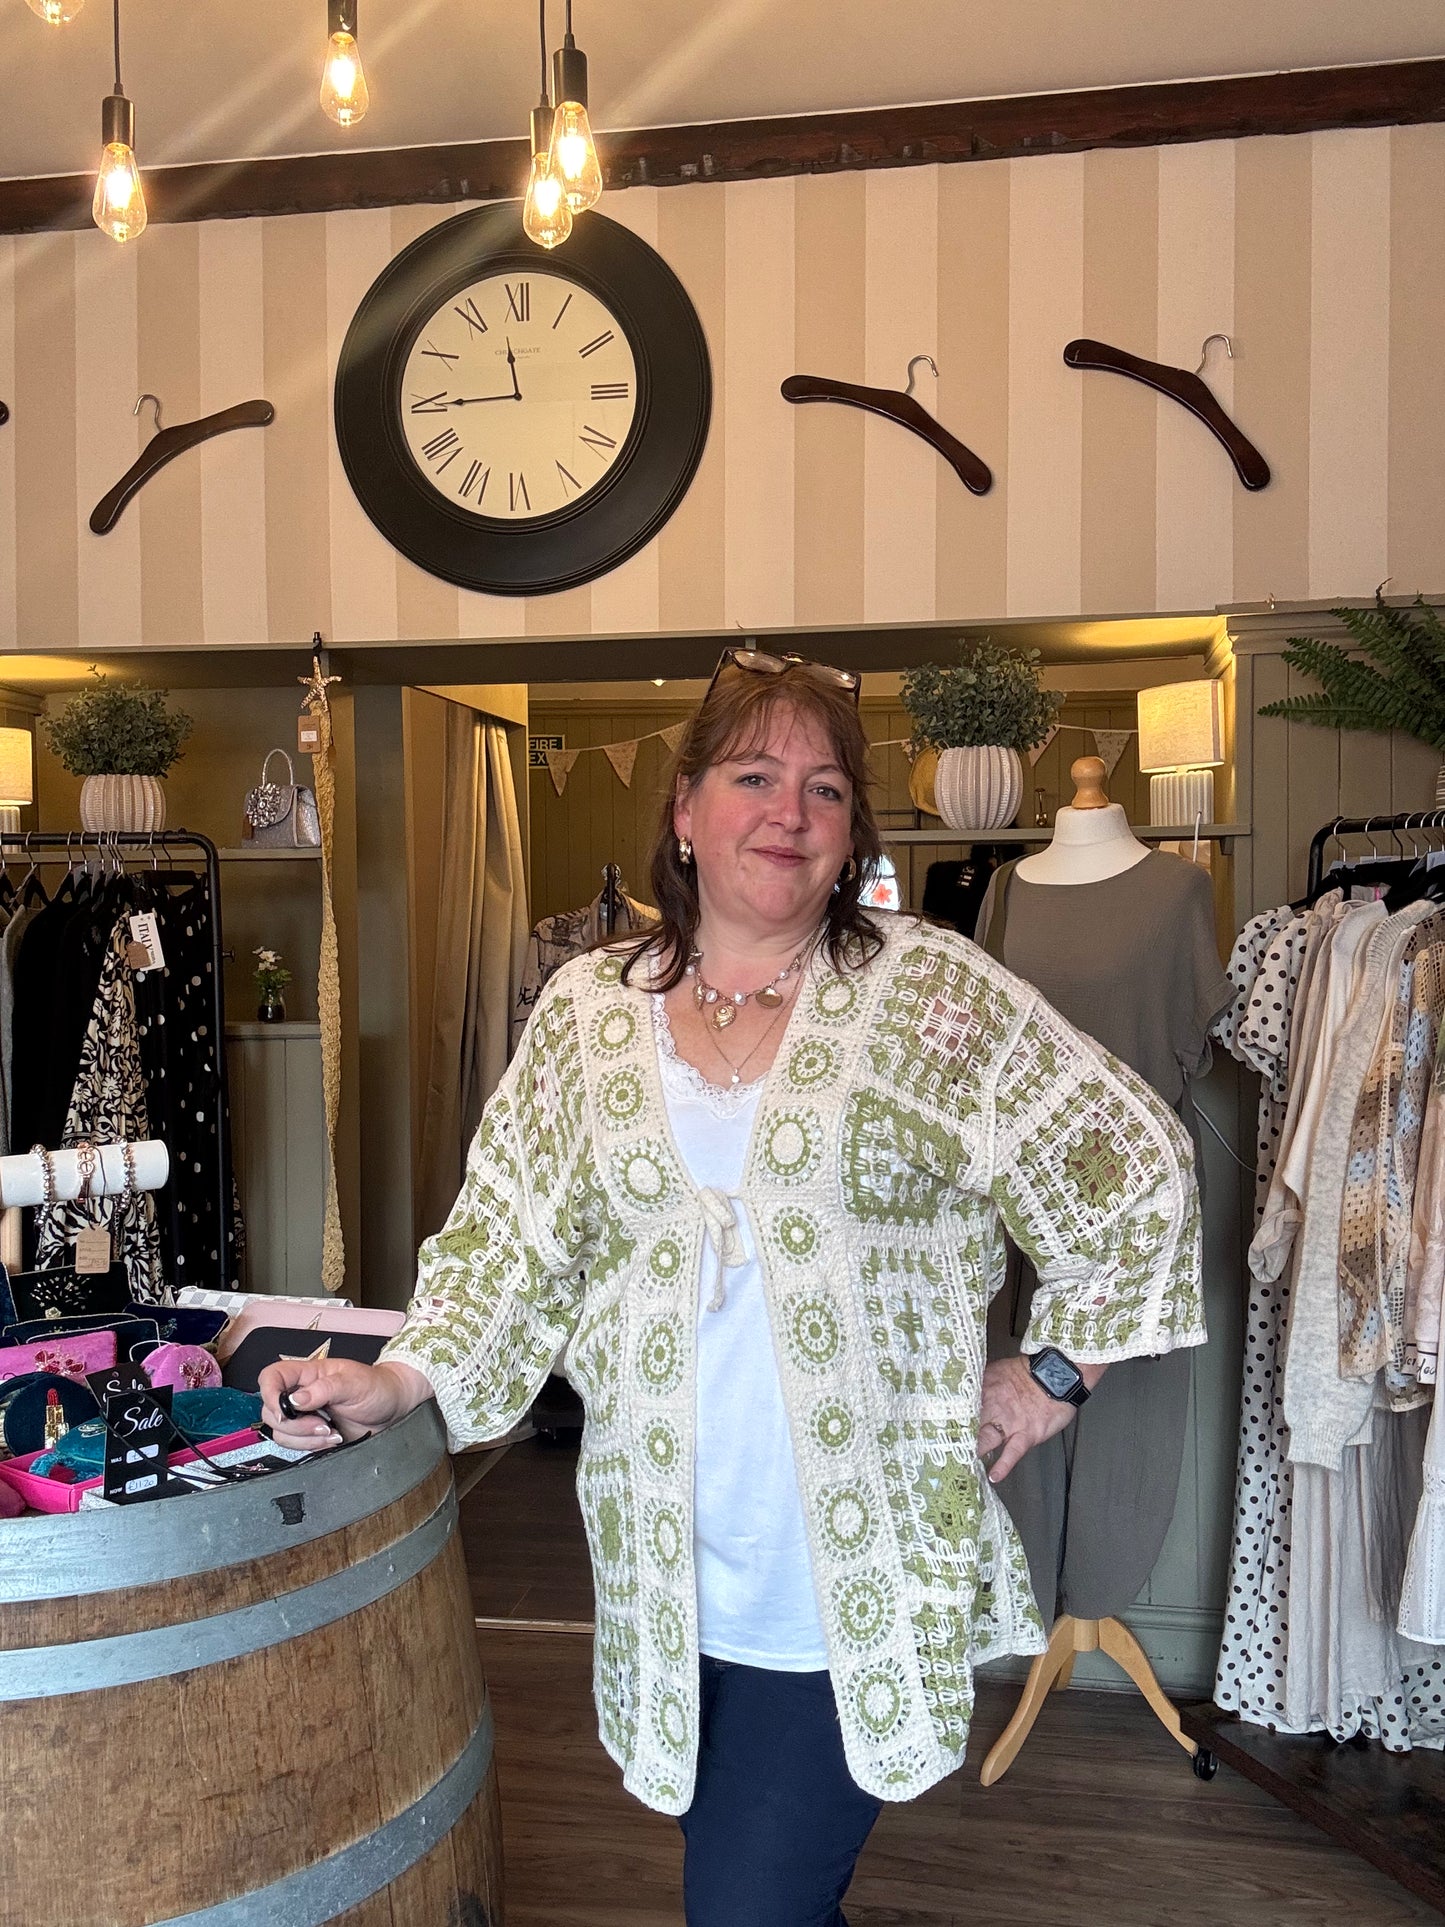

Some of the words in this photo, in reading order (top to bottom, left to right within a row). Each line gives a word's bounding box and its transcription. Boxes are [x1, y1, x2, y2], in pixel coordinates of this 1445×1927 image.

[453, 297, 489, 341] XI
[504, 282, 530, 323] XII
[420, 339, 460, 371] X
[578, 330, 615, 359] II
[410, 391, 448, 414] IX
[590, 383, 629, 400] III
[421, 427, 465, 475] VIII
[578, 424, 618, 462] IV
[457, 459, 491, 505] VII
[509, 472, 532, 512] VI
[555, 459, 583, 498] V
[529, 738, 558, 750] FIRE
[529, 752, 547, 765] EX
[114, 1406, 163, 1438] Sale
